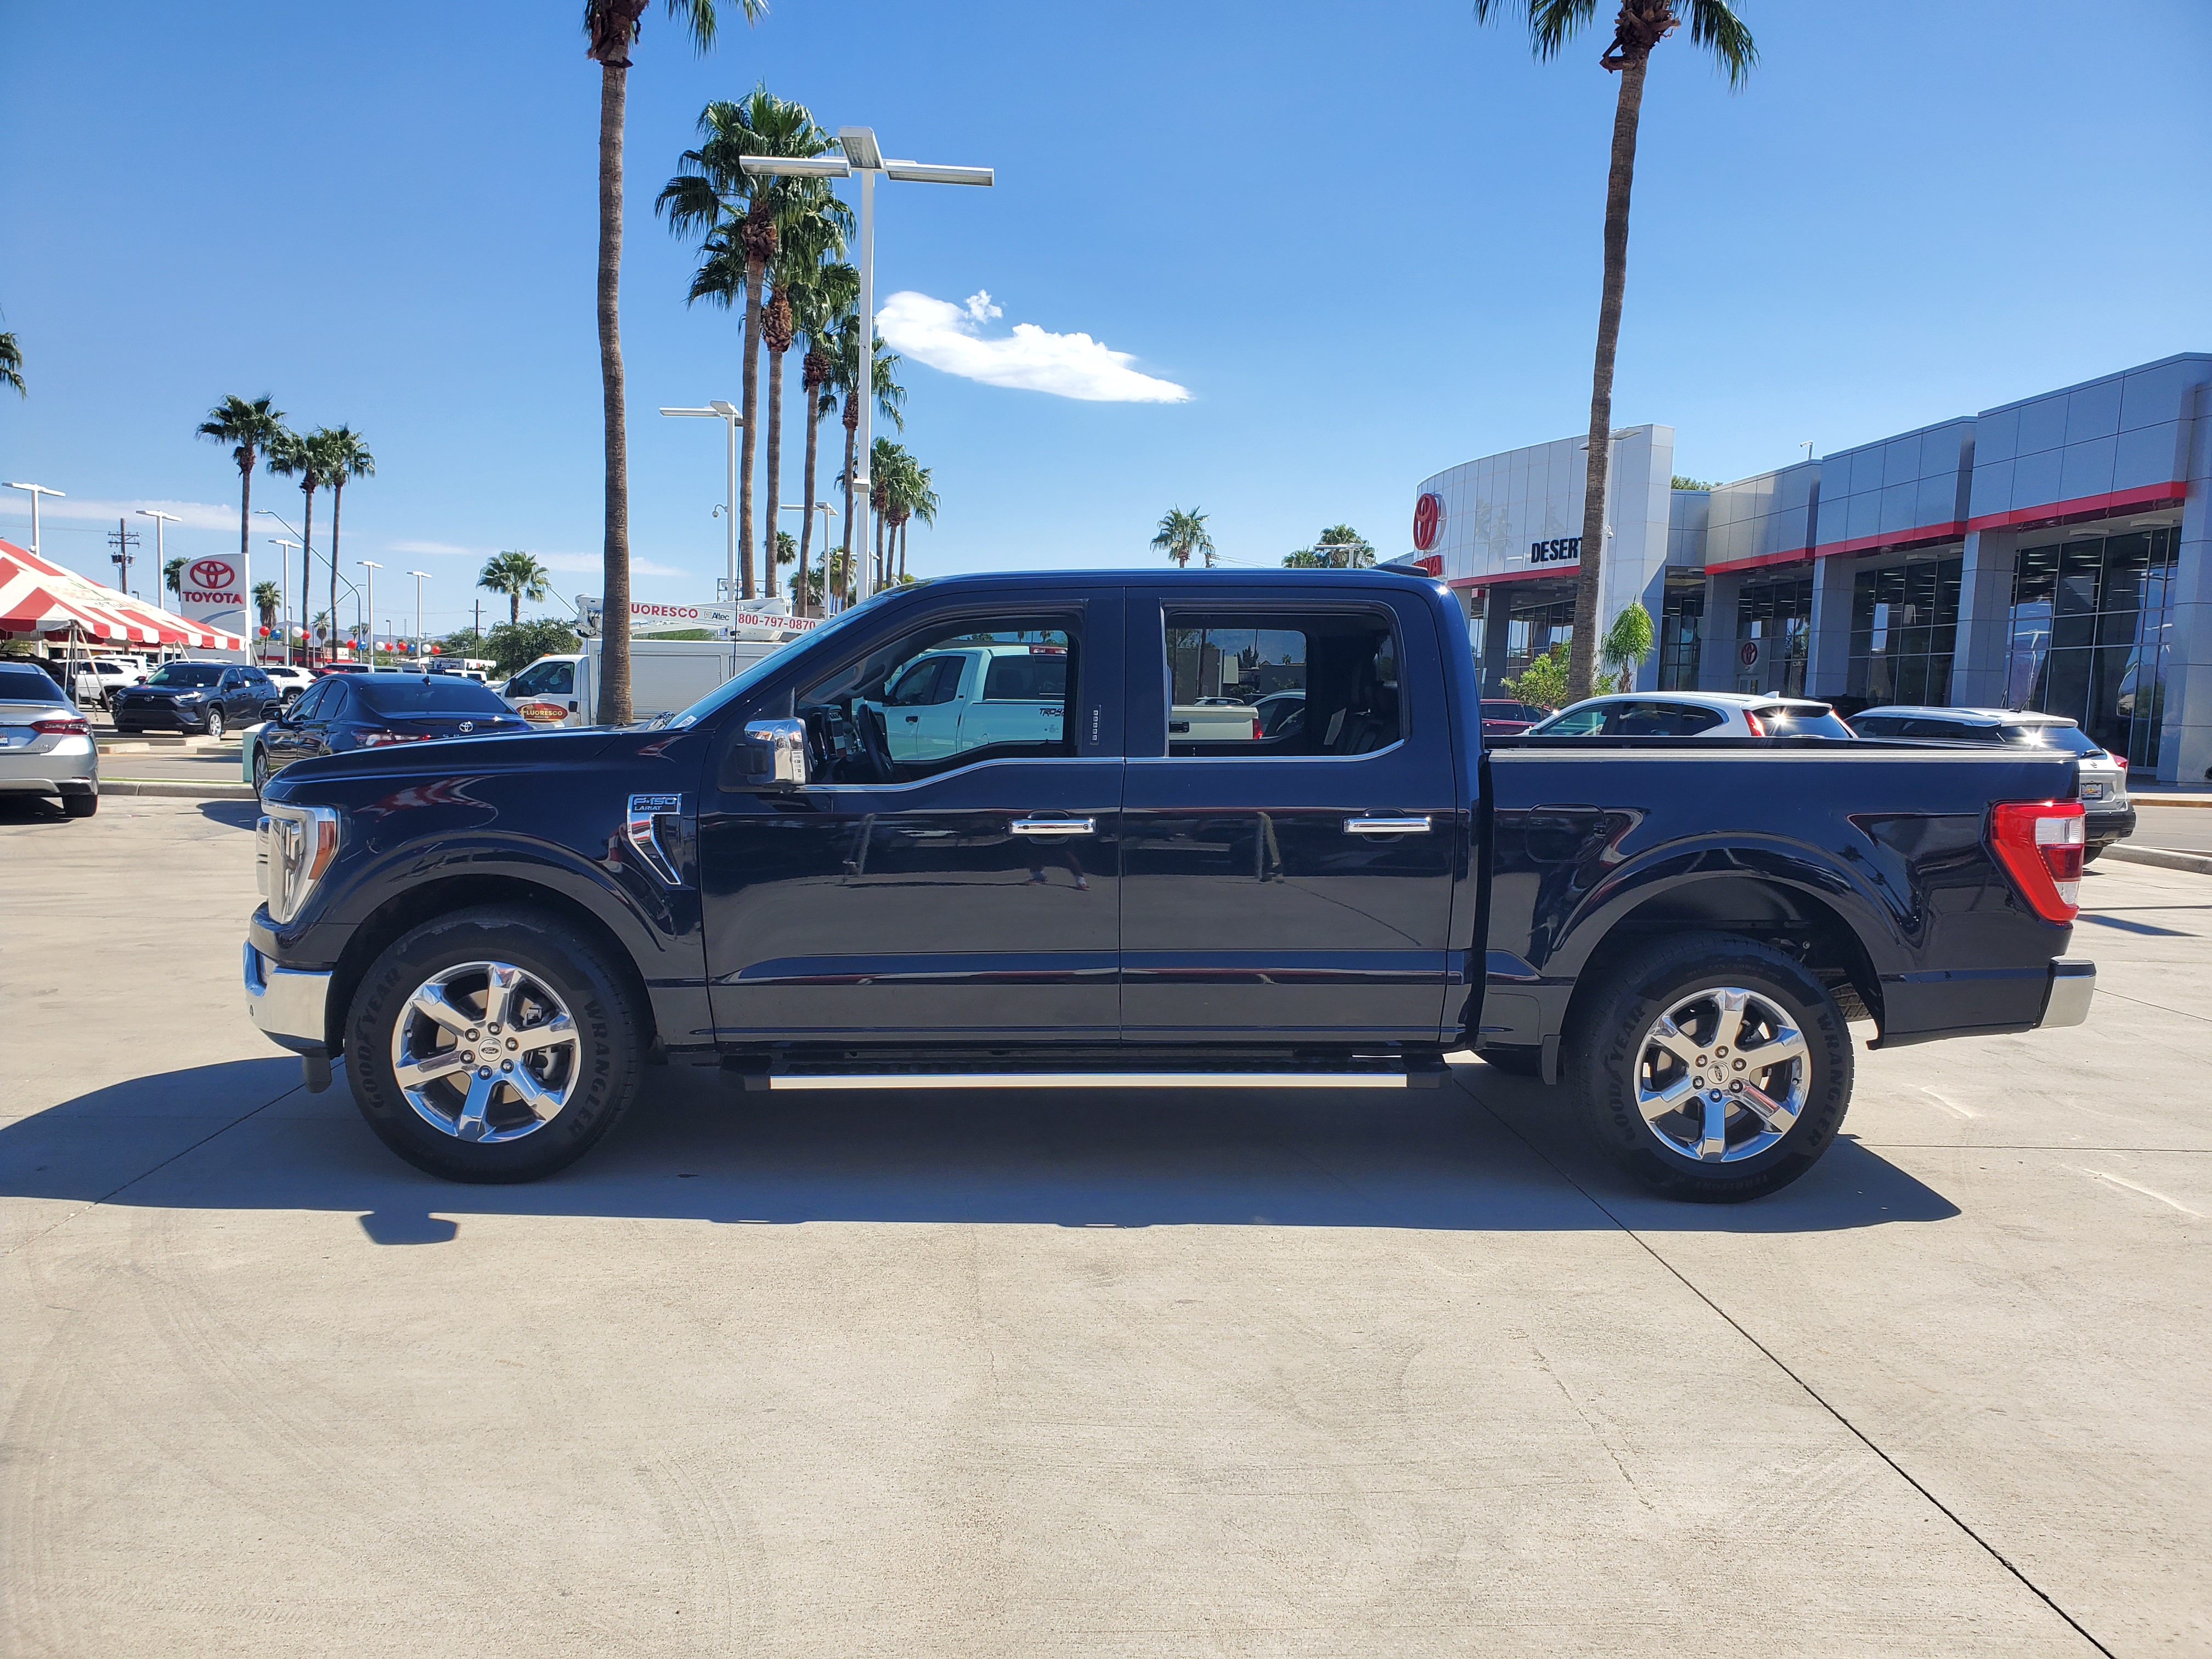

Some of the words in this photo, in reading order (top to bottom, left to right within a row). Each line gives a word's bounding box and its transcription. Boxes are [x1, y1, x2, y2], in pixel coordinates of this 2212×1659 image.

[183, 591, 243, 604] TOYOTA
[631, 603, 698, 619] UORESCO
[712, 611, 730, 621] Altec
[738, 613, 816, 630] 800-797-0870
[634, 797, 677, 805] F-150
[567, 999, 610, 1138] WRANGLER
[1806, 1012, 1842, 1147] WRANGLER
